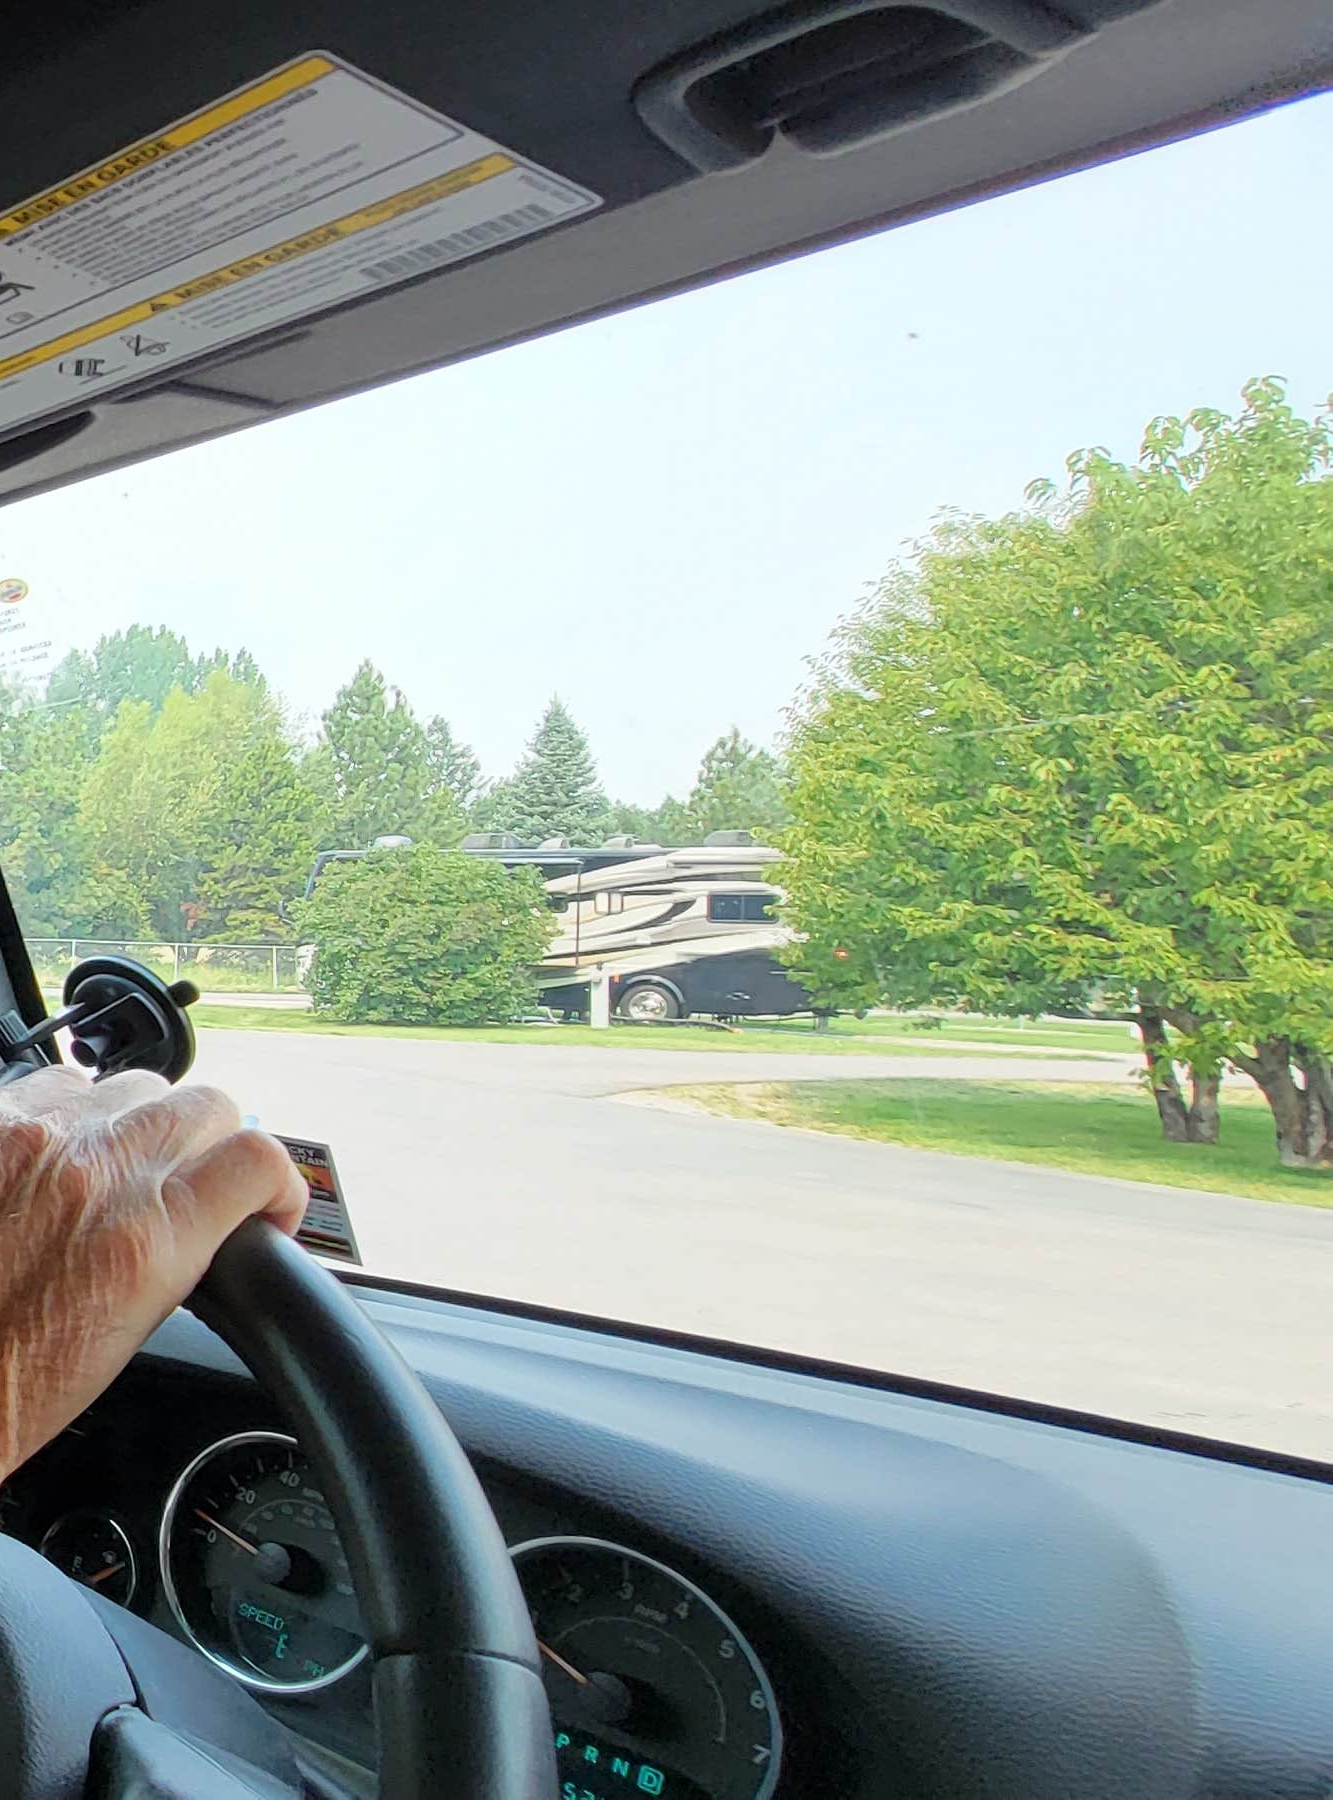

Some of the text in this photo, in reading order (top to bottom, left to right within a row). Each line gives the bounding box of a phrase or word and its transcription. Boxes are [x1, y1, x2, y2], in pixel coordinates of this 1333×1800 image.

[12, 141, 172, 223] MISE EN GARDE
[281, 1471, 301, 1488] 40
[236, 1486, 256, 1505] 20
[207, 1529, 218, 1544] 0
[237, 1603, 285, 1631] SPEED
[674, 1602, 689, 1619] 4
[719, 1639, 734, 1659] 5
[750, 1690, 766, 1709] 6
[555, 1732, 571, 1749] P
[585, 1745, 600, 1763] R
[612, 1757, 630, 1776] N
[752, 1744, 770, 1764] 7
